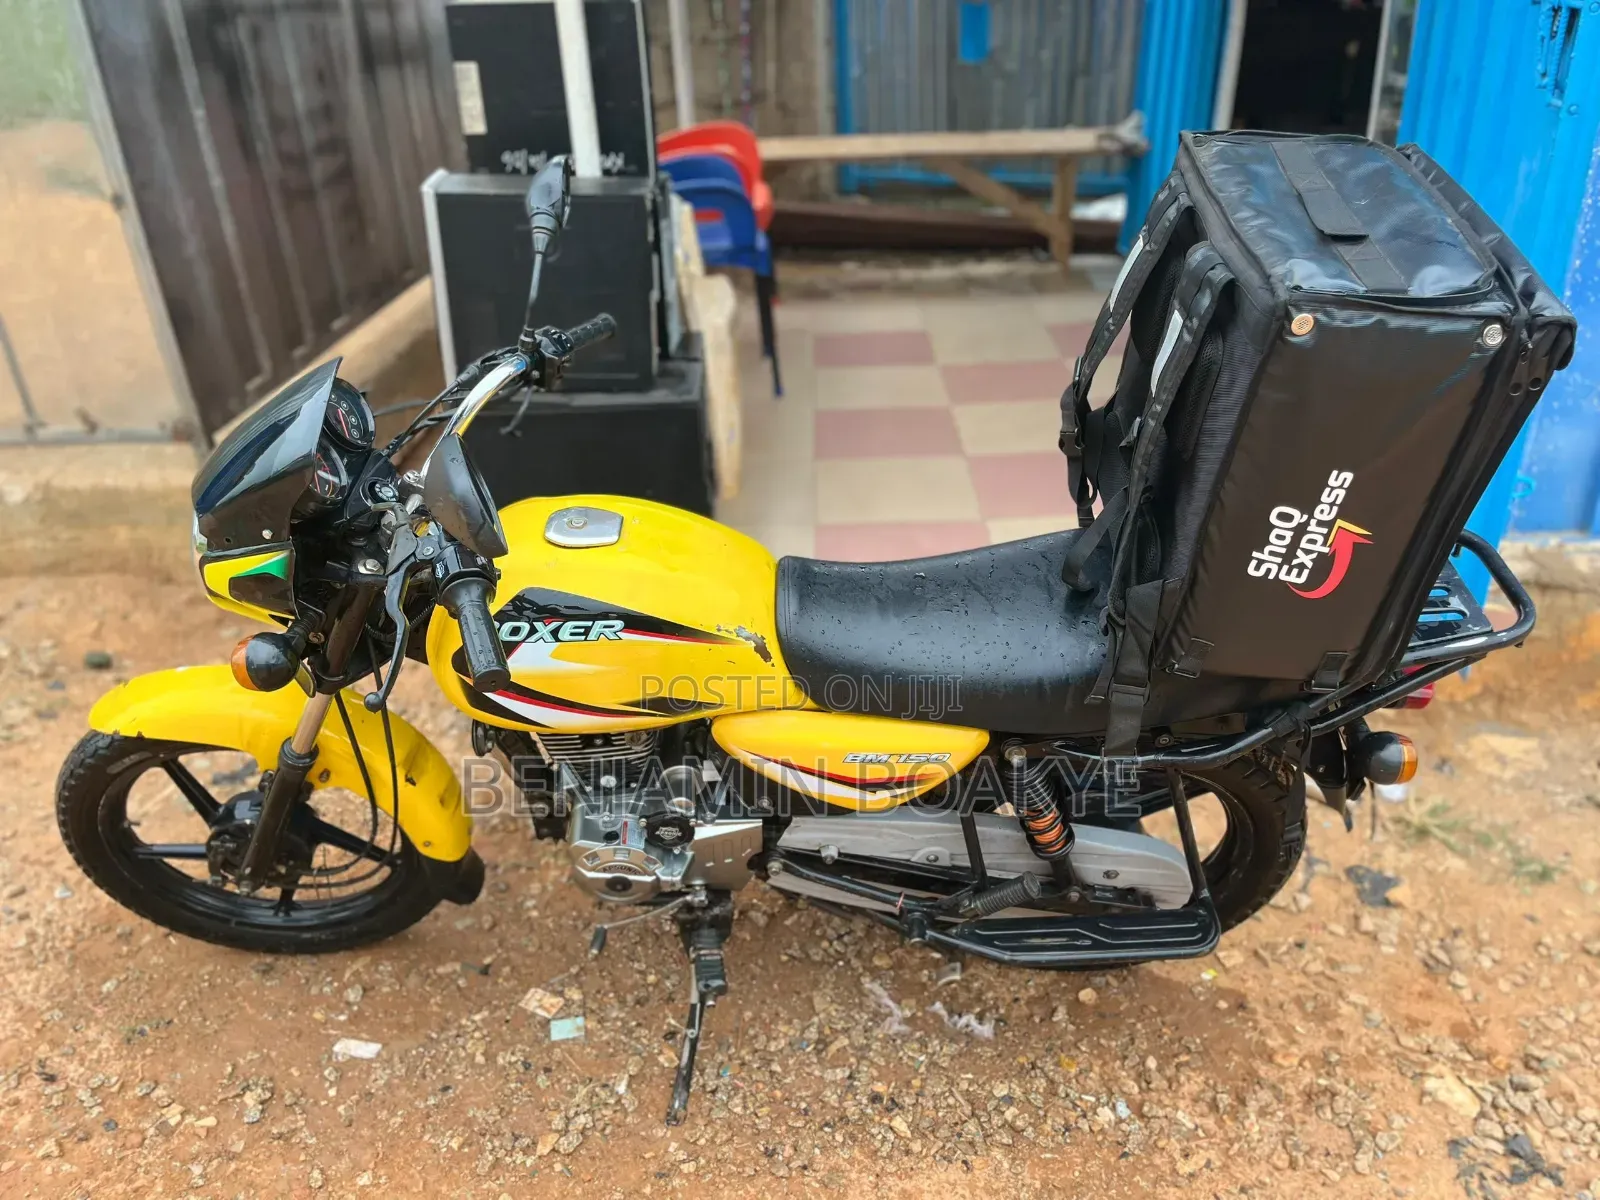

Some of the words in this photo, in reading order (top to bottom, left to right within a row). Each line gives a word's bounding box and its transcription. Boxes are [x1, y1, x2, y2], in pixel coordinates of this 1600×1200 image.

[1247, 505, 1309, 580] ShaQ
[1278, 469, 1354, 584] Express
[494, 618, 625, 643] OXER
[843, 752, 891, 764] BM
[896, 752, 952, 764] 150
